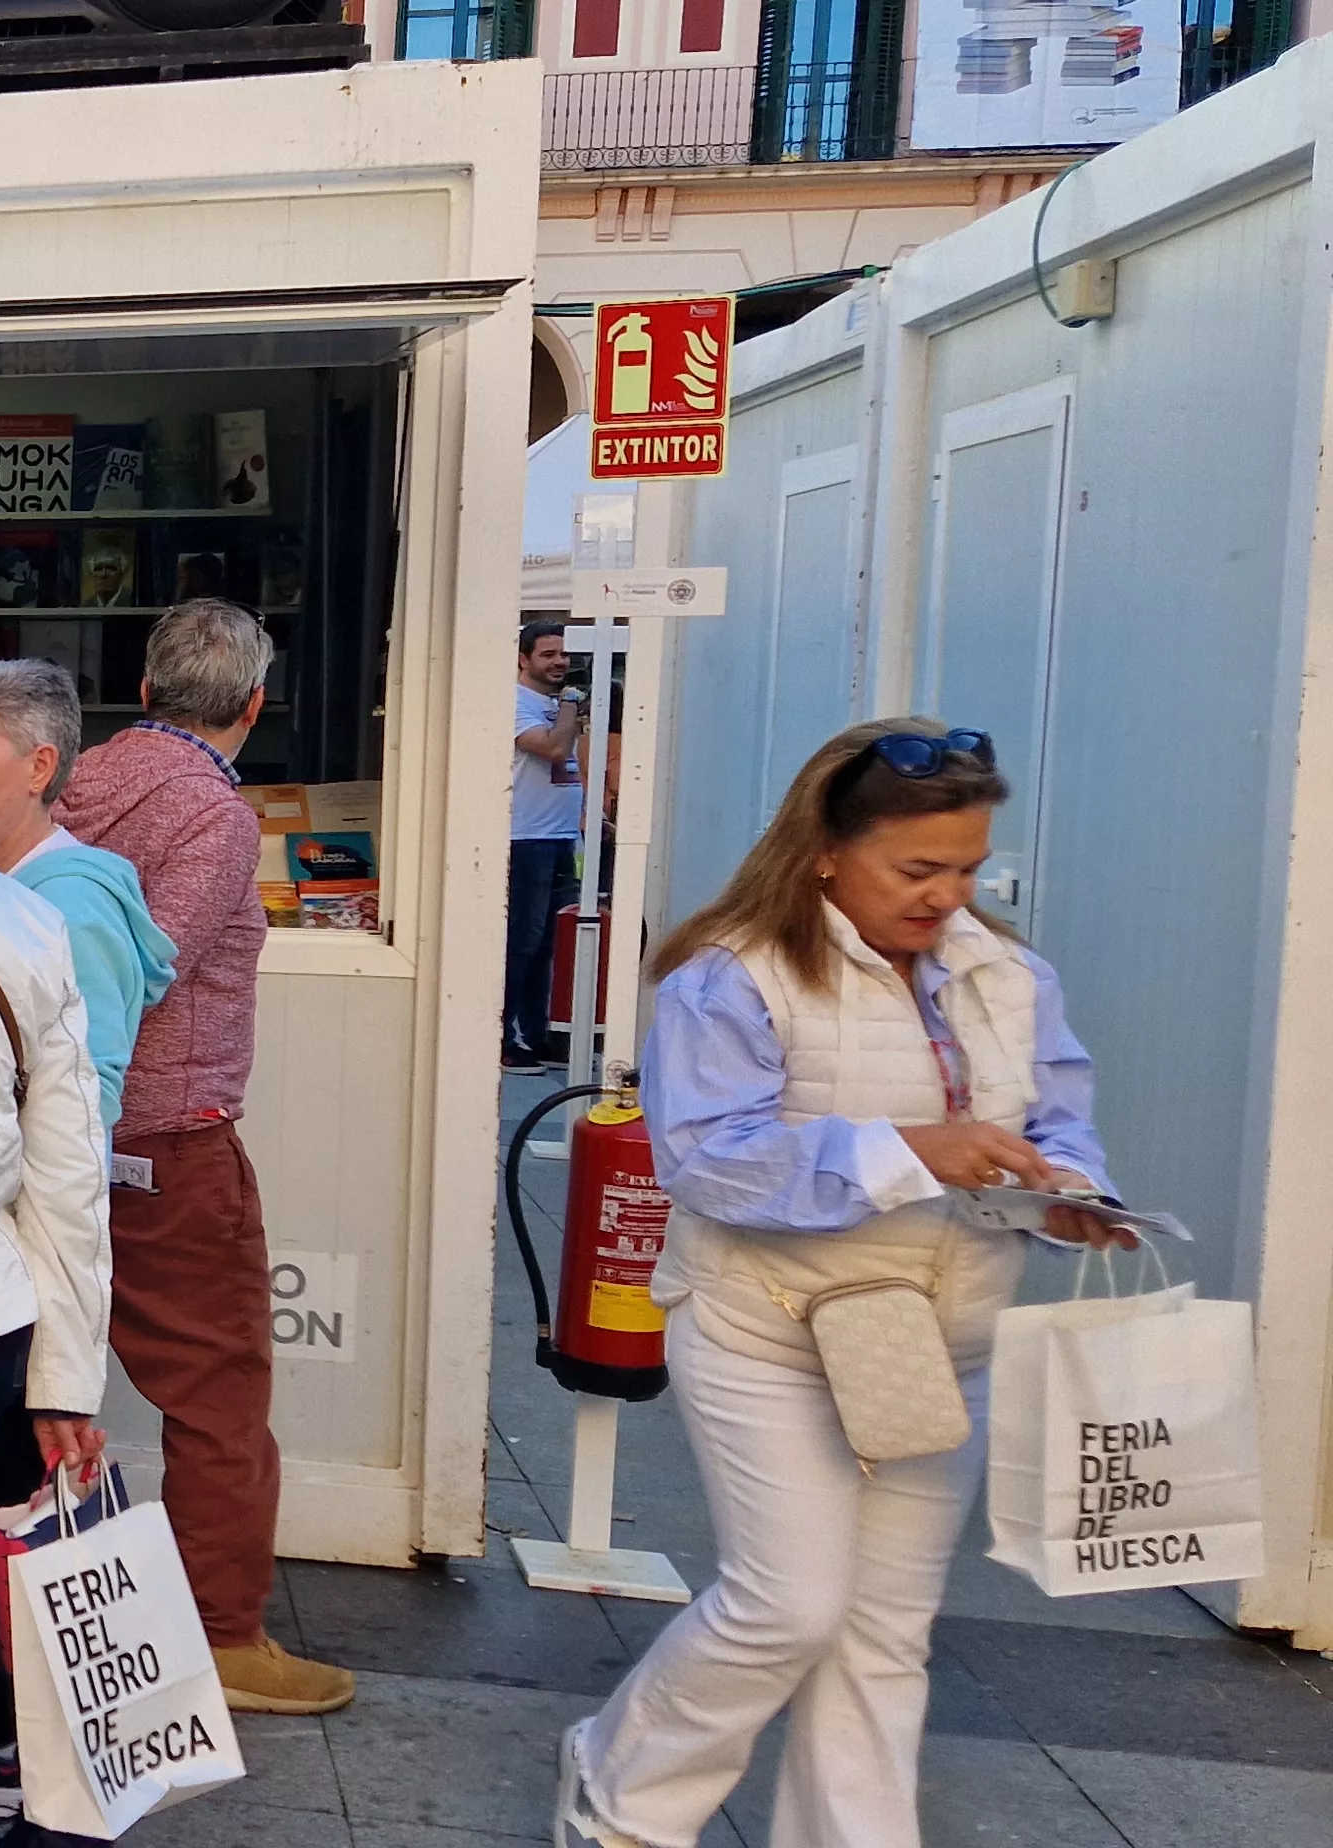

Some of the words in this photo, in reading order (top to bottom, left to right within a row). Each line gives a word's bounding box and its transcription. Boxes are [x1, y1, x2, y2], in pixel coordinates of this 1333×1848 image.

[111, 451, 139, 467] LOS
[598, 435, 719, 466] EXTINTOR
[1080, 1417, 1173, 1453] FERIA
[1080, 1454, 1139, 1484] DEL
[1079, 1479, 1173, 1515] LIBRO
[1075, 1515, 1117, 1541] DE
[1075, 1533, 1206, 1574] HUESCA
[42, 1556, 138, 1624] FERIA
[56, 1614, 119, 1669] DEL
[69, 1642, 161, 1716] LIBRO
[81, 1707, 120, 1759] DE
[93, 1714, 217, 1805] HUESCA
